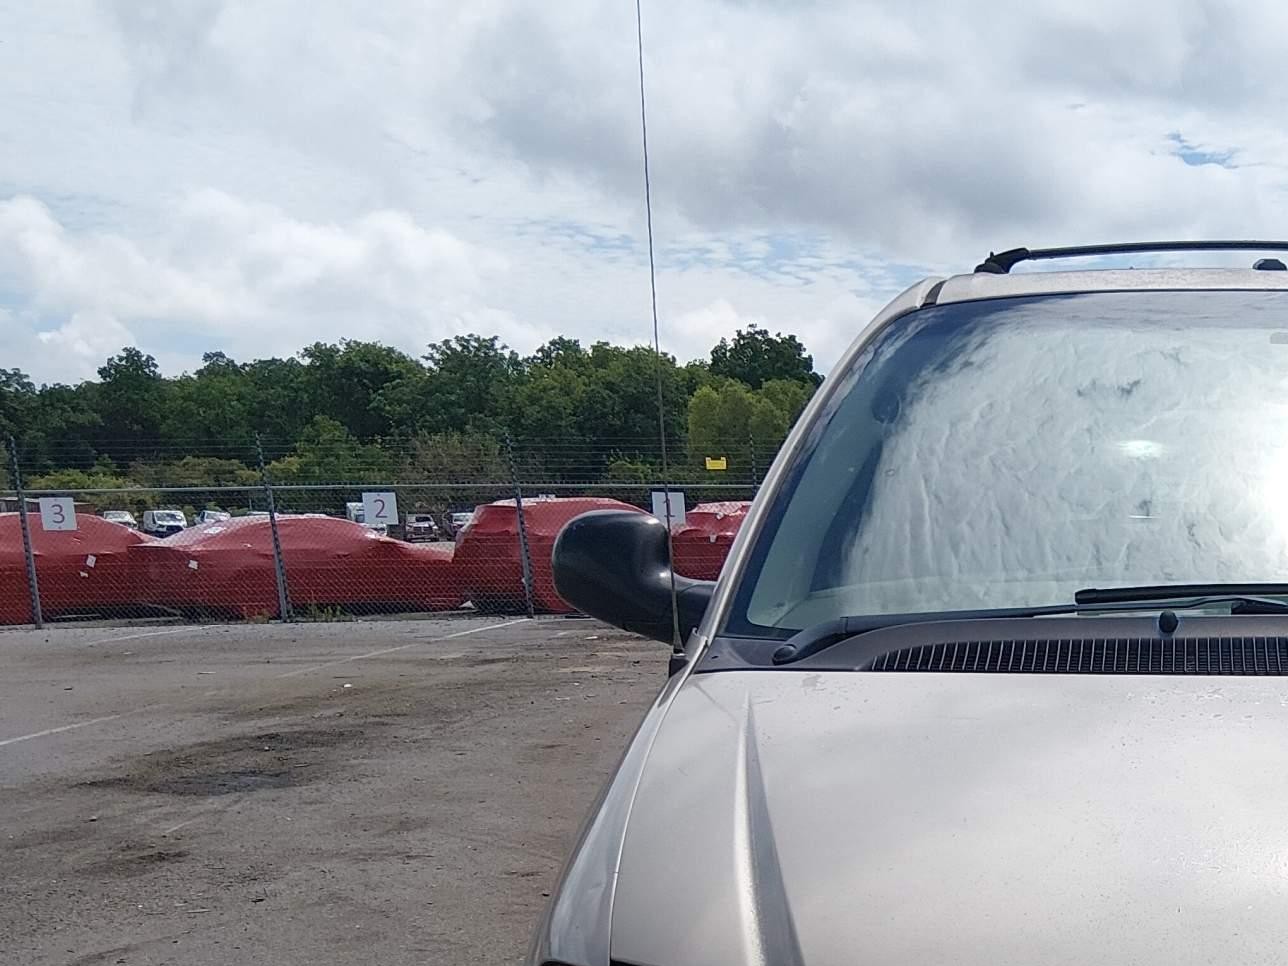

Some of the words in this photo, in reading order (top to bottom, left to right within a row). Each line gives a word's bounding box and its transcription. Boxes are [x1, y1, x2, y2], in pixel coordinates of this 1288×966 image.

[51, 503, 65, 524] 3
[374, 498, 388, 518] 2
[662, 498, 676, 517] 1
